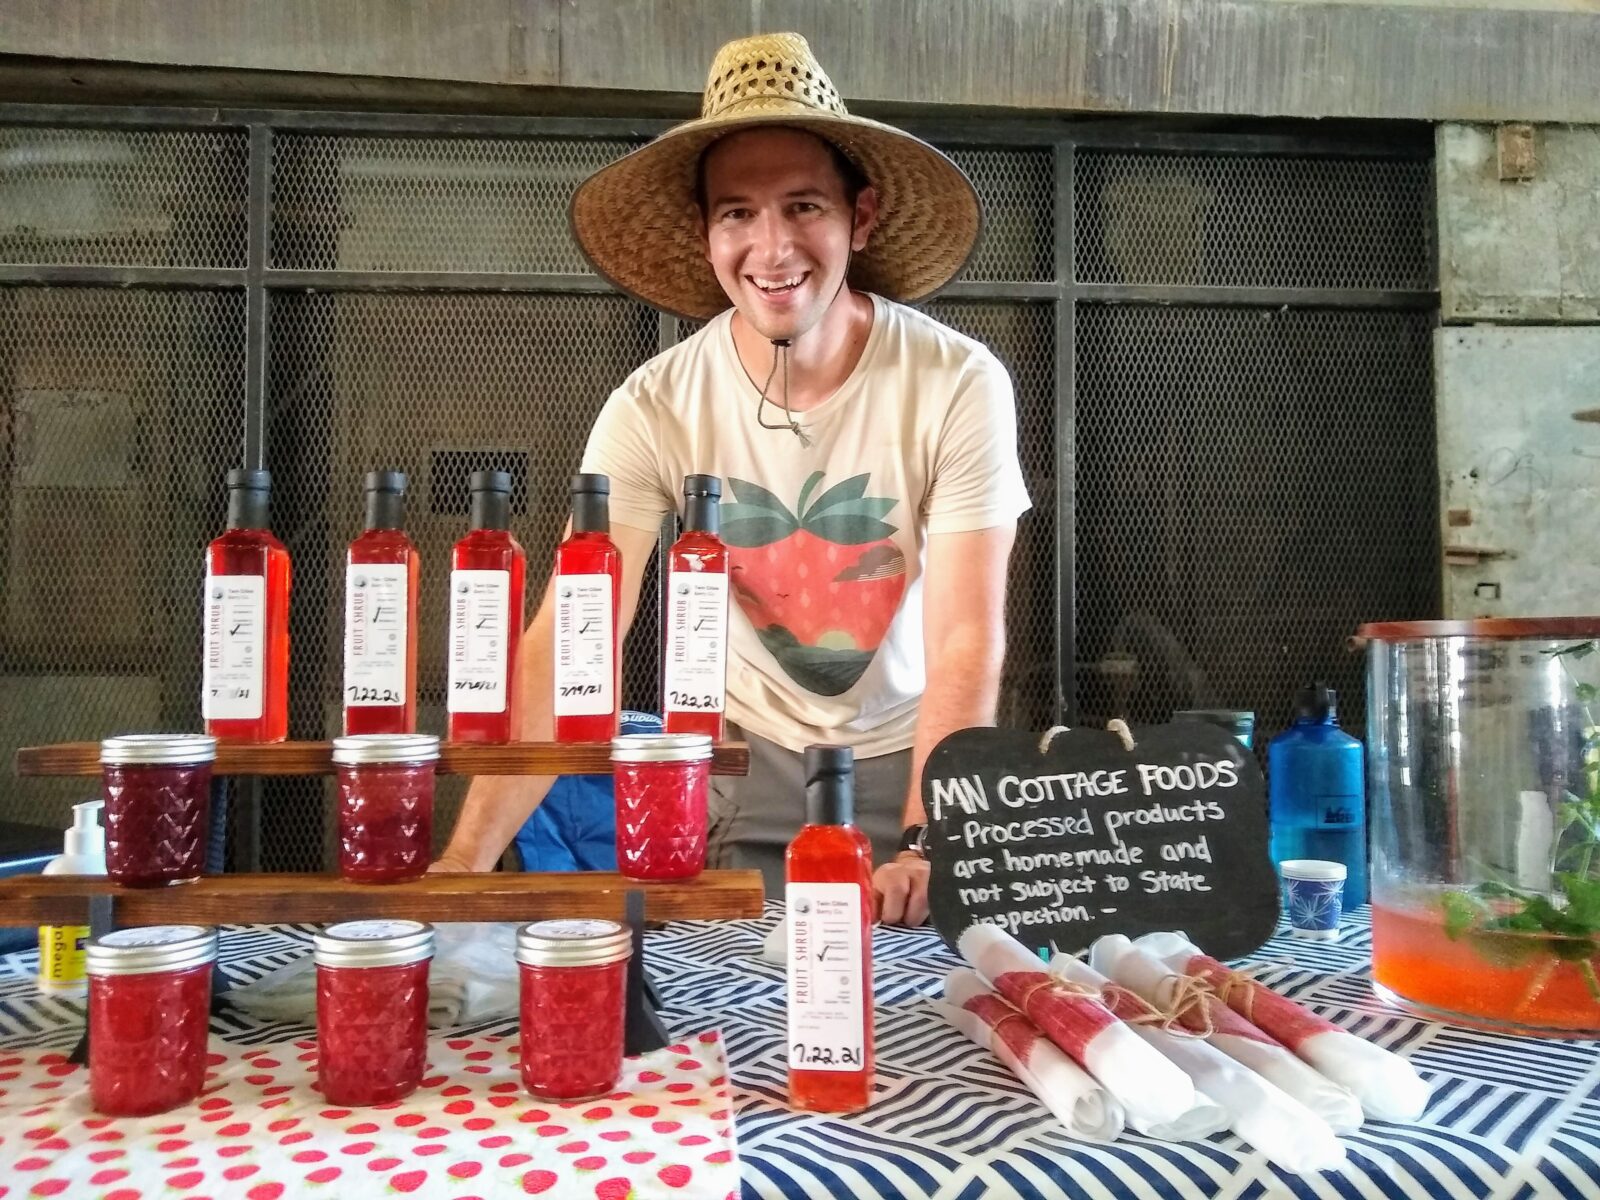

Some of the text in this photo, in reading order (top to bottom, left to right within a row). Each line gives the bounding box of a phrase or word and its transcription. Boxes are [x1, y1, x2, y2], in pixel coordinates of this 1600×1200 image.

[209, 604, 221, 668] FRUIT SHRUB
[353, 592, 364, 656] FRUIT SHRUB
[456, 599, 466, 662] FRUIT SHRUB
[560, 603, 570, 666] FRUIT SHRUB
[675, 600, 686, 662] FRUIT SHRUB
[931, 760, 1239, 820] MN COTTAGE FOODS
[1104, 800, 1225, 845] products
[953, 835, 1212, 879] are homemade and
[959, 884, 1003, 906] not
[1106, 874, 1130, 893] to
[54, 928, 67, 978] mega
[795, 921, 809, 1004] FRUIT SHRUB
[793, 1043, 860, 1066] 7.22.21
